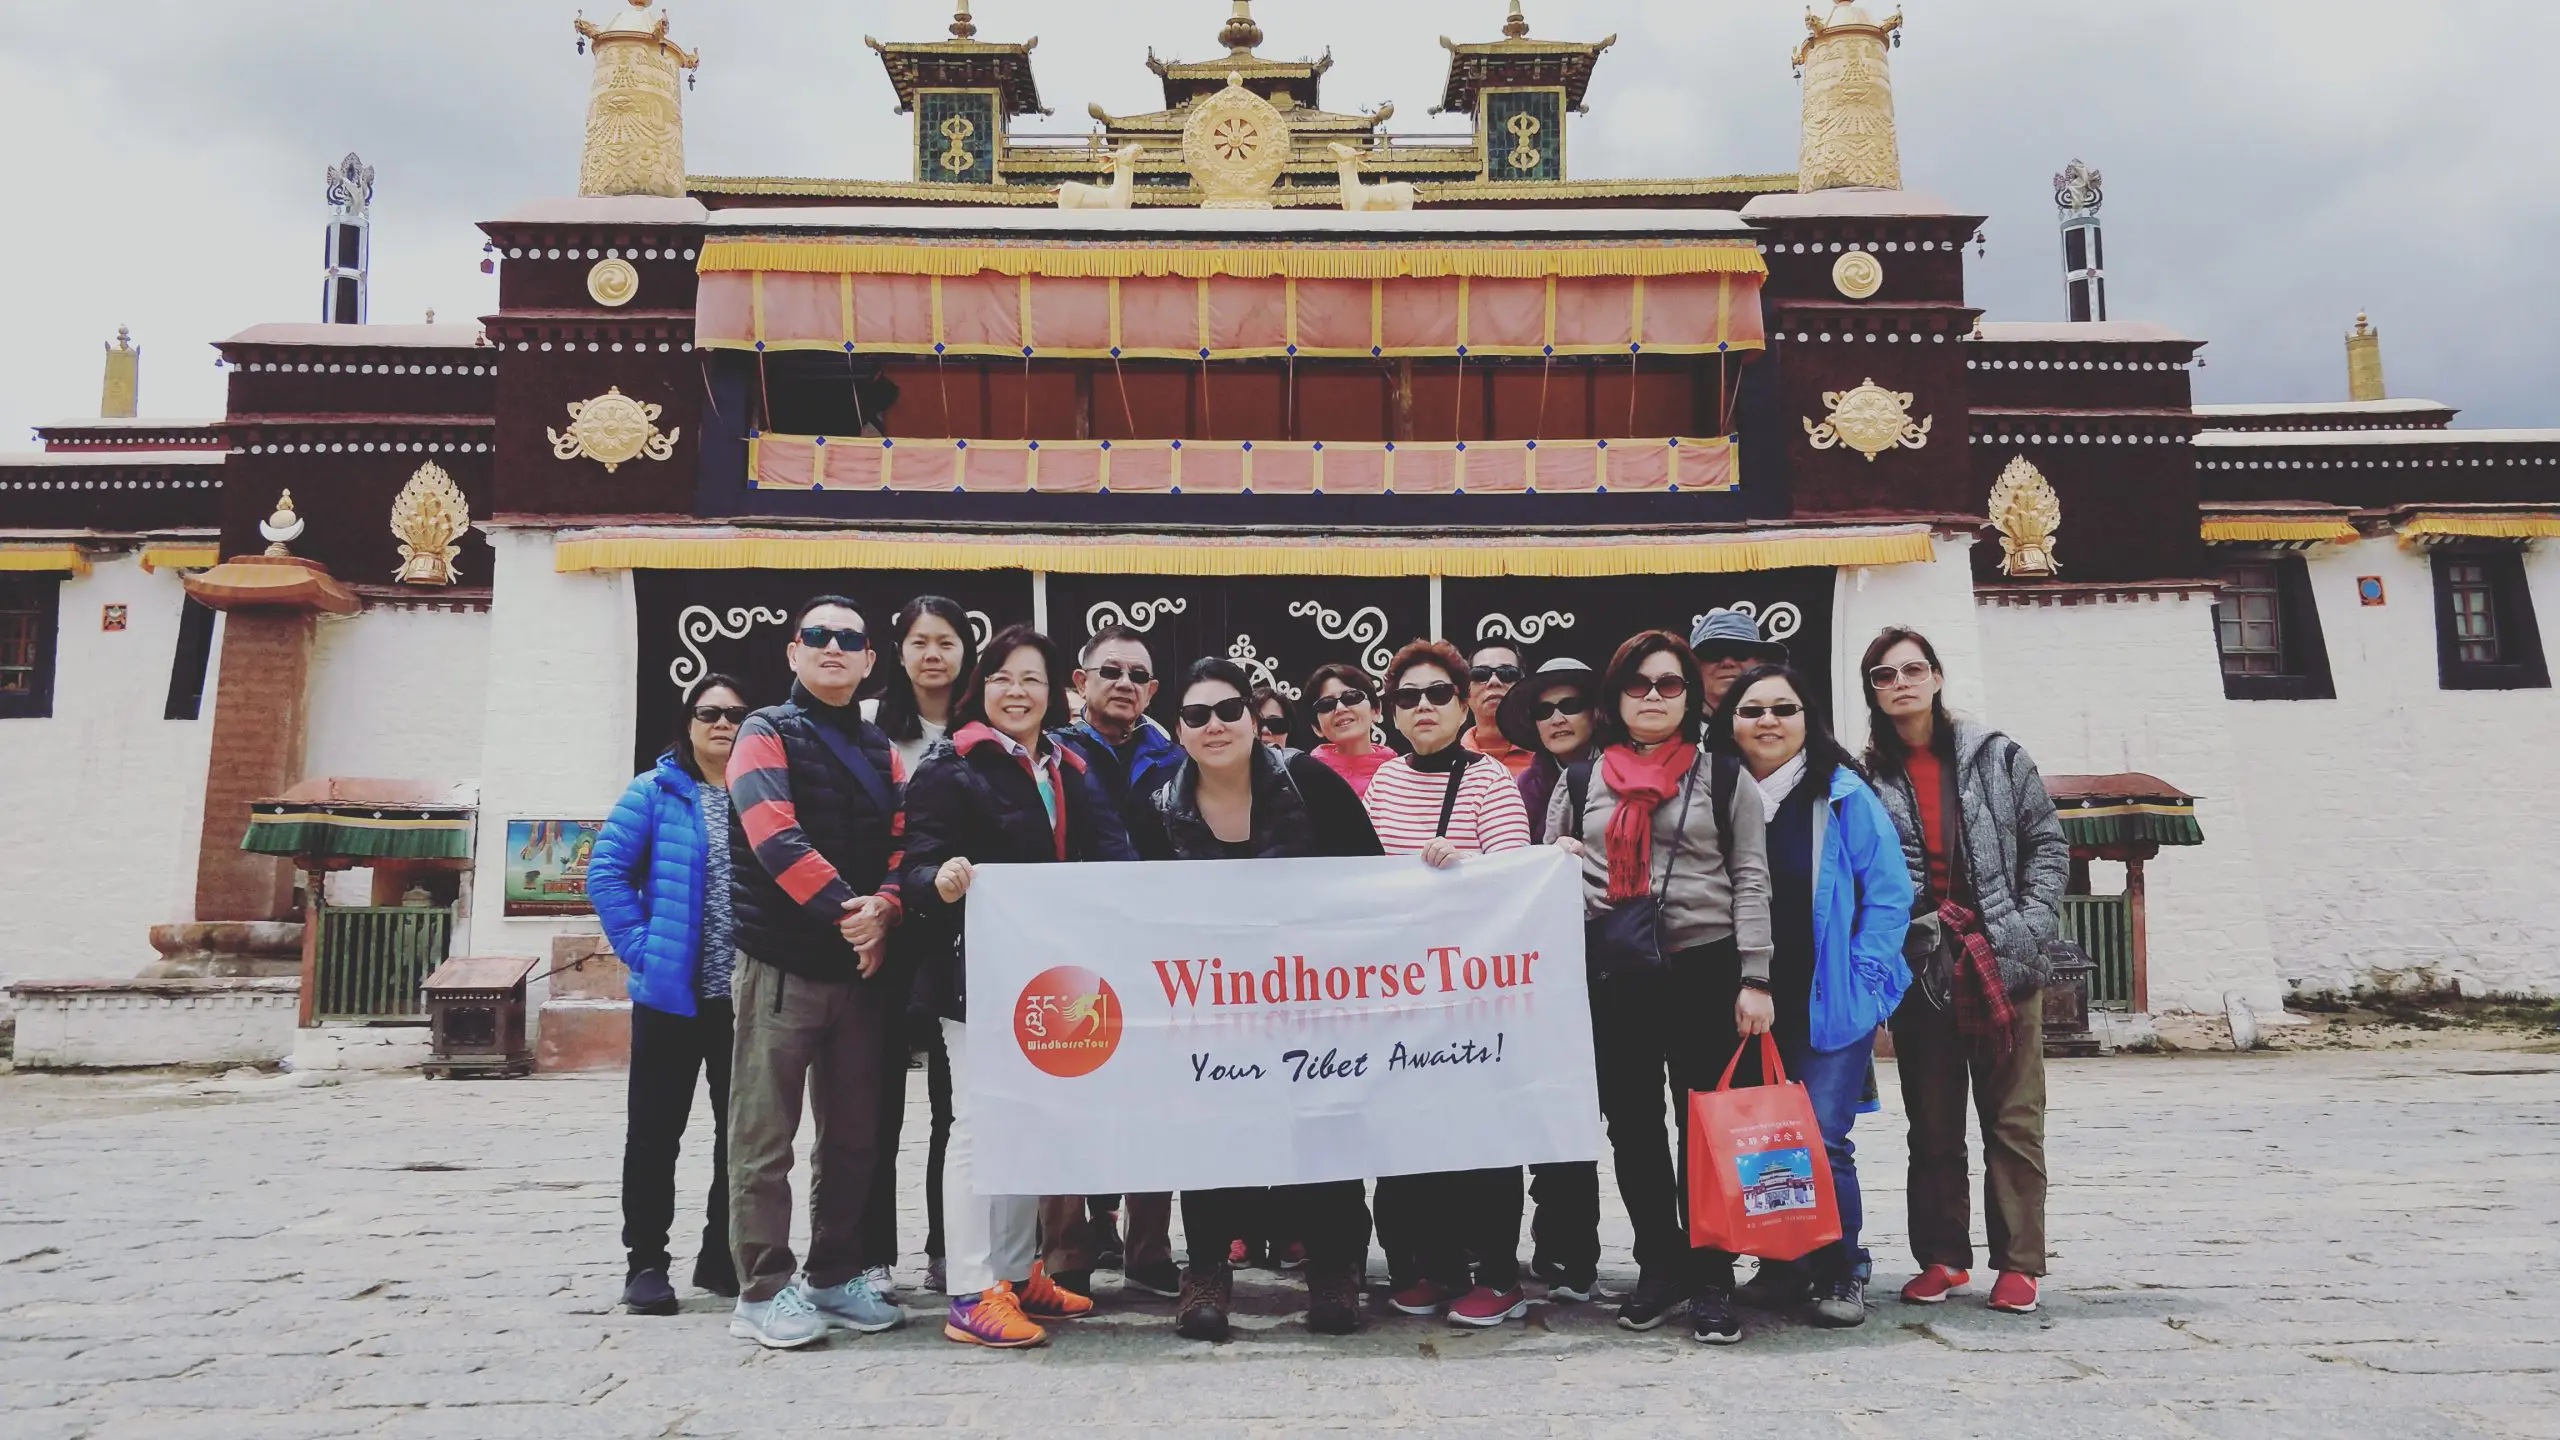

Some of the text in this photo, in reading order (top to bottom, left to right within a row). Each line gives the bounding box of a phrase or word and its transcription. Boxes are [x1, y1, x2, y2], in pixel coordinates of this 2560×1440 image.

[1151, 946, 1540, 1008] WindhorseTour
[1027, 1038, 1109, 1051] WindhorseTour
[1191, 1032, 1504, 1083] Your Tibet Awaits!
